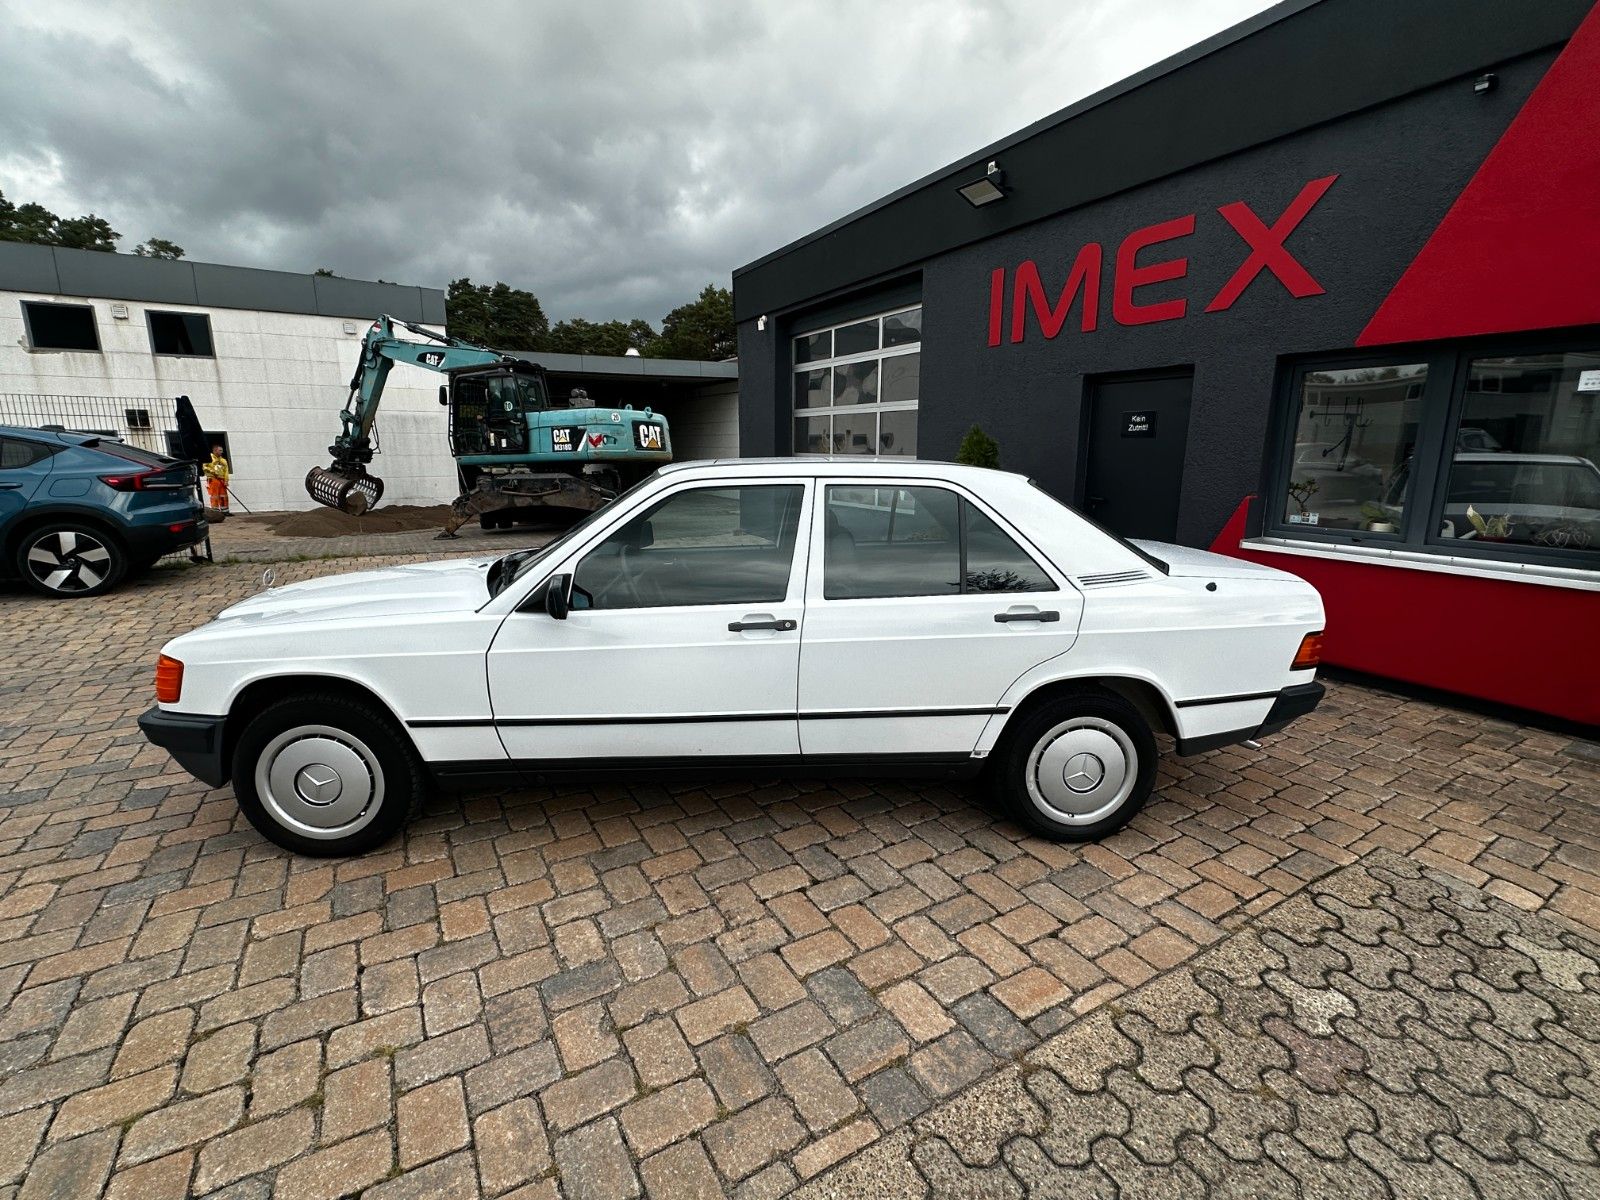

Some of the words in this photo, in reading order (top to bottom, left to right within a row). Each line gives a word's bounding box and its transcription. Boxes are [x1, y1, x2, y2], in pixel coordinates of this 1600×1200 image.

[987, 173, 1340, 348] IMEX
[425, 353, 438, 366] CAT
[553, 429, 570, 443] CAT
[640, 424, 662, 448] CAT
